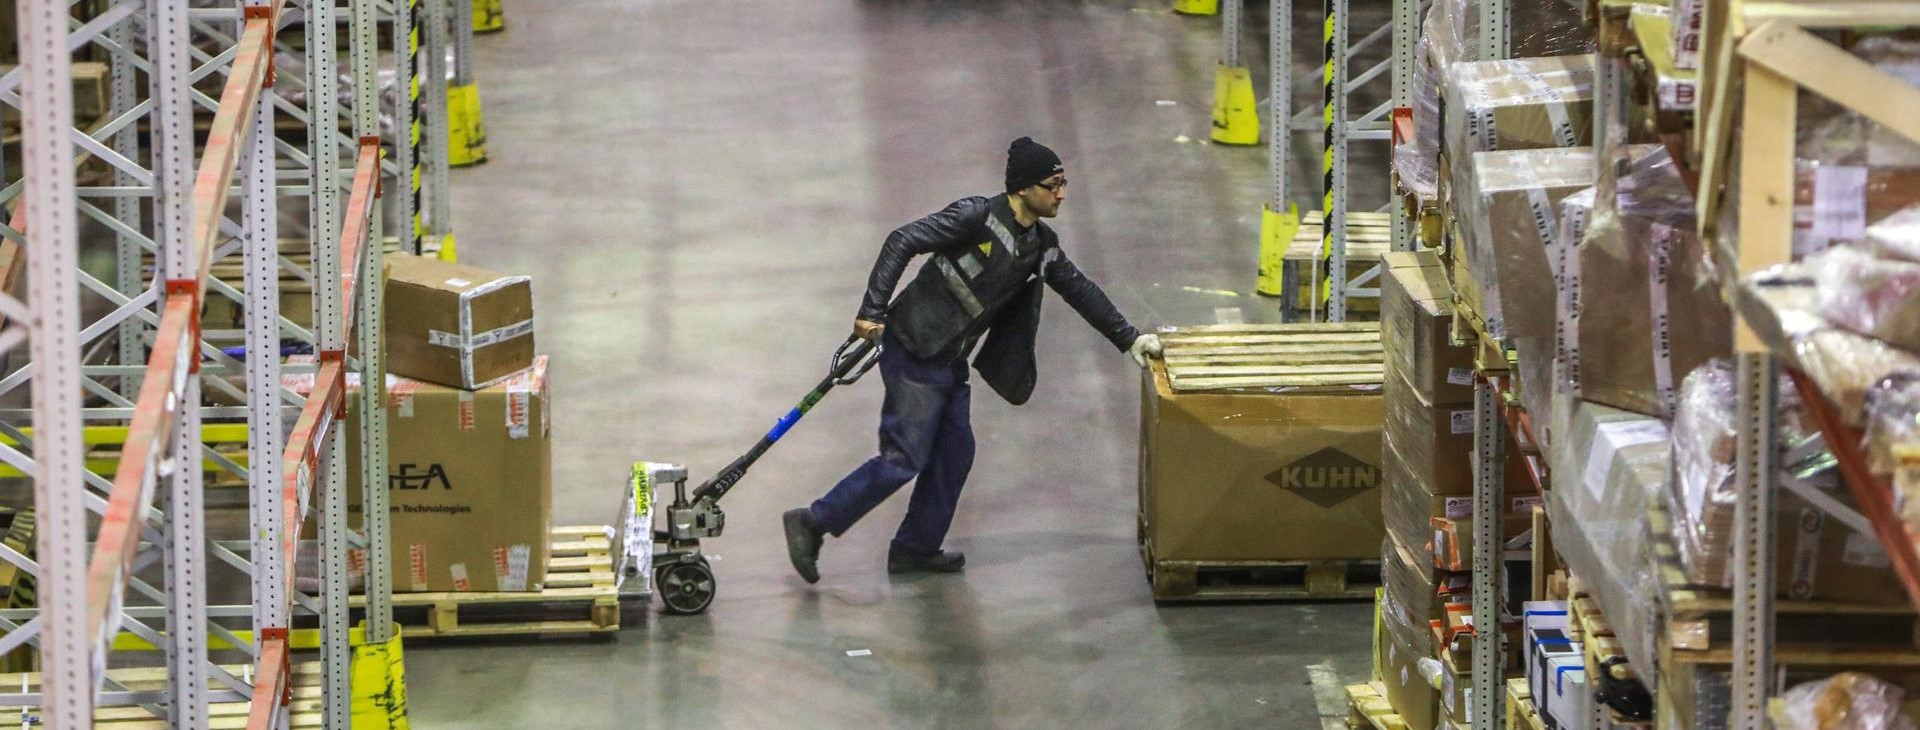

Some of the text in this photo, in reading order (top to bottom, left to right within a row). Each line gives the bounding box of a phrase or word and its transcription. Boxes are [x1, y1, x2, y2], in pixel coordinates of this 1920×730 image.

[389, 463, 452, 490] EA
[1281, 466, 1376, 488] KUHN
[403, 505, 471, 515] Technologies
